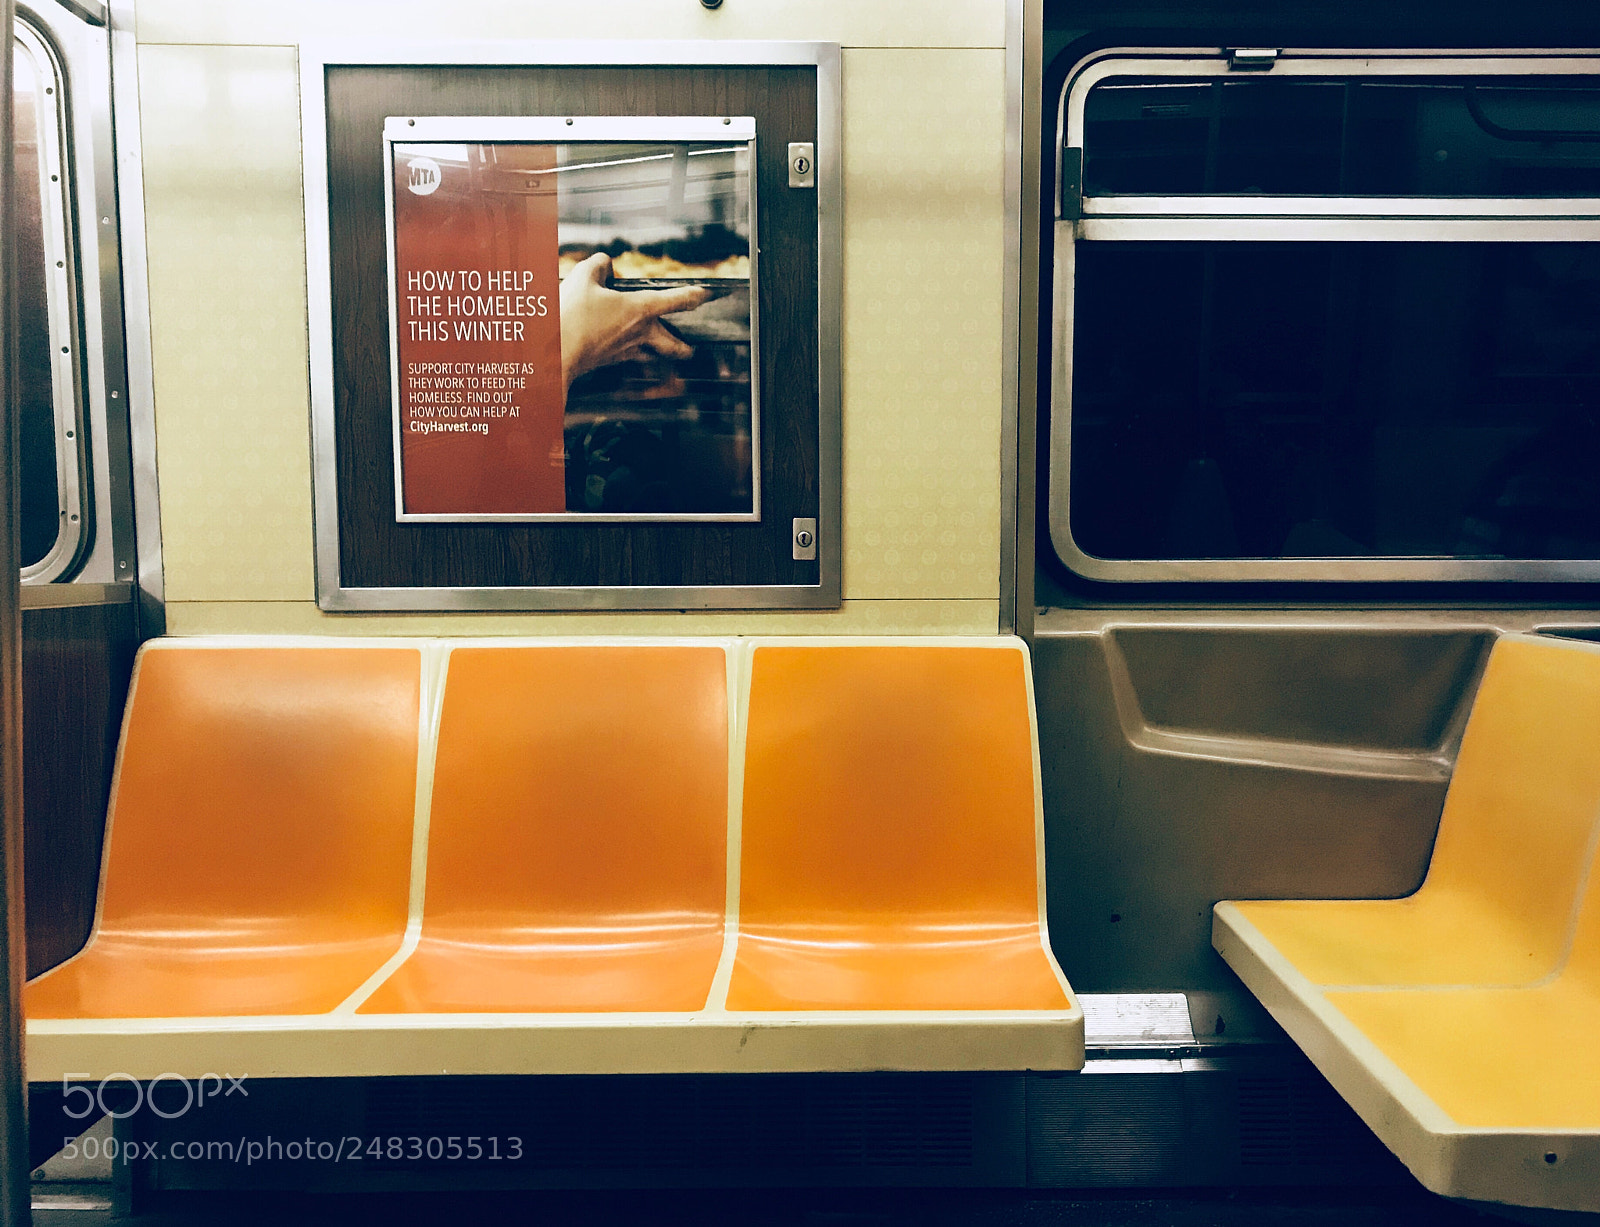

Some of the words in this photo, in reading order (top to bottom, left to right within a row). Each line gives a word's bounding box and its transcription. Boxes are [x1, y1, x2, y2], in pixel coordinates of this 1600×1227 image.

[408, 167, 436, 187] MTA
[408, 270, 455, 291] HOW
[458, 270, 482, 291] TO
[488, 270, 534, 291] HELP
[407, 295, 442, 316] THE
[448, 295, 548, 317] HOMELESS
[407, 320, 449, 341] THIS
[453, 320, 525, 342] WINTER
[408, 362, 453, 375] SUPPORT
[454, 362, 475, 374] CITY
[477, 362, 520, 375] HARVEST
[521, 362, 534, 375] AS
[408, 377, 433, 389] THEY
[434, 377, 465, 389] WORK
[466, 377, 479, 389] TO
[481, 377, 506, 389] FEED
[507, 377, 526, 389] THE
[409, 391, 465, 404] HOMELESS.
[467, 391, 491, 404] FIND
[493, 391, 513, 404] OUT
[409, 406, 435, 418] HOW
[436, 406, 458, 418] YOU
[460, 406, 480, 418] CAN
[482, 406, 508, 418] HELP
[509, 406, 521, 418] AT
[409, 420, 489, 435] CityHarvest.org
